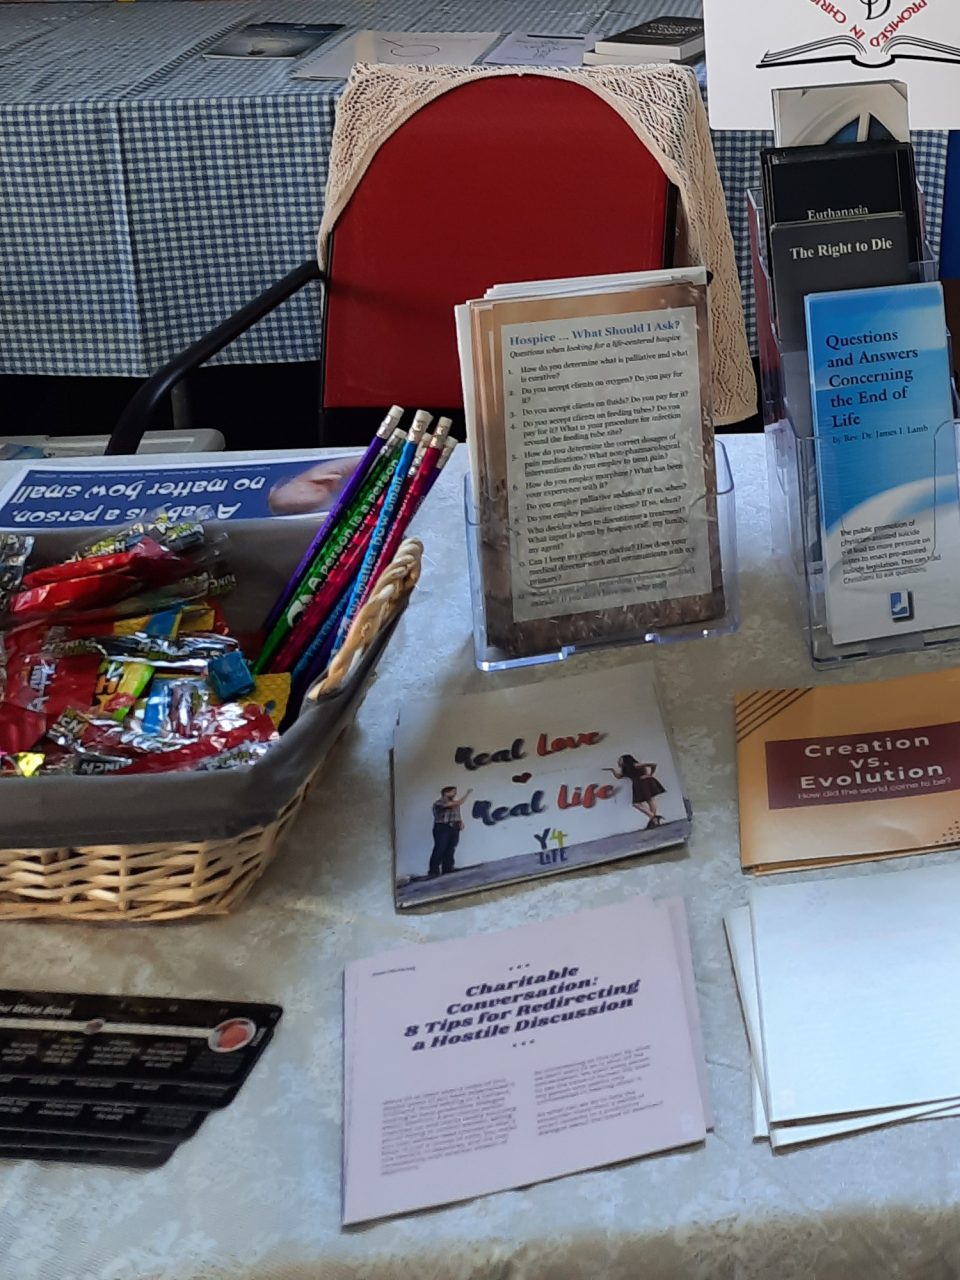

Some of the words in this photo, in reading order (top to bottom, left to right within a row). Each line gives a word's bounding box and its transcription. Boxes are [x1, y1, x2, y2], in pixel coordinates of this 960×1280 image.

[807, 204, 869, 220] Euthanasia
[789, 247, 815, 260] The
[817, 242, 852, 258] Right
[855, 241, 869, 252] to
[871, 237, 893, 251] Die
[509, 333, 556, 346] Hospice
[570, 328, 603, 340] What
[604, 323, 645, 337] Should
[646, 322, 652, 333] I
[653, 319, 681, 332] Ask?
[825, 330, 899, 351] Questions
[826, 352, 854, 369] and
[858, 348, 919, 365] Answers
[827, 367, 914, 391] Concerning
[830, 393, 854, 408] the
[856, 387, 888, 405] End
[891, 385, 910, 400] of
[830, 411, 861, 428] Life
[537, 730, 601, 757] Love
[804, 736, 930, 758] Creation
[848, 757, 889, 769] vs.
[800, 765, 943, 789] Evolution
[557, 783, 616, 810] Life
[465, 966, 580, 998] Charitable
[403, 1025, 420, 1038] 8
[424, 1016, 474, 1034] Tips
[477, 1009, 513, 1025] for
[515, 979, 641, 1017] Redirecting
[411, 1040, 426, 1052] a
[430, 1023, 511, 1048] Hostile
[513, 997, 634, 1033] Discussion
